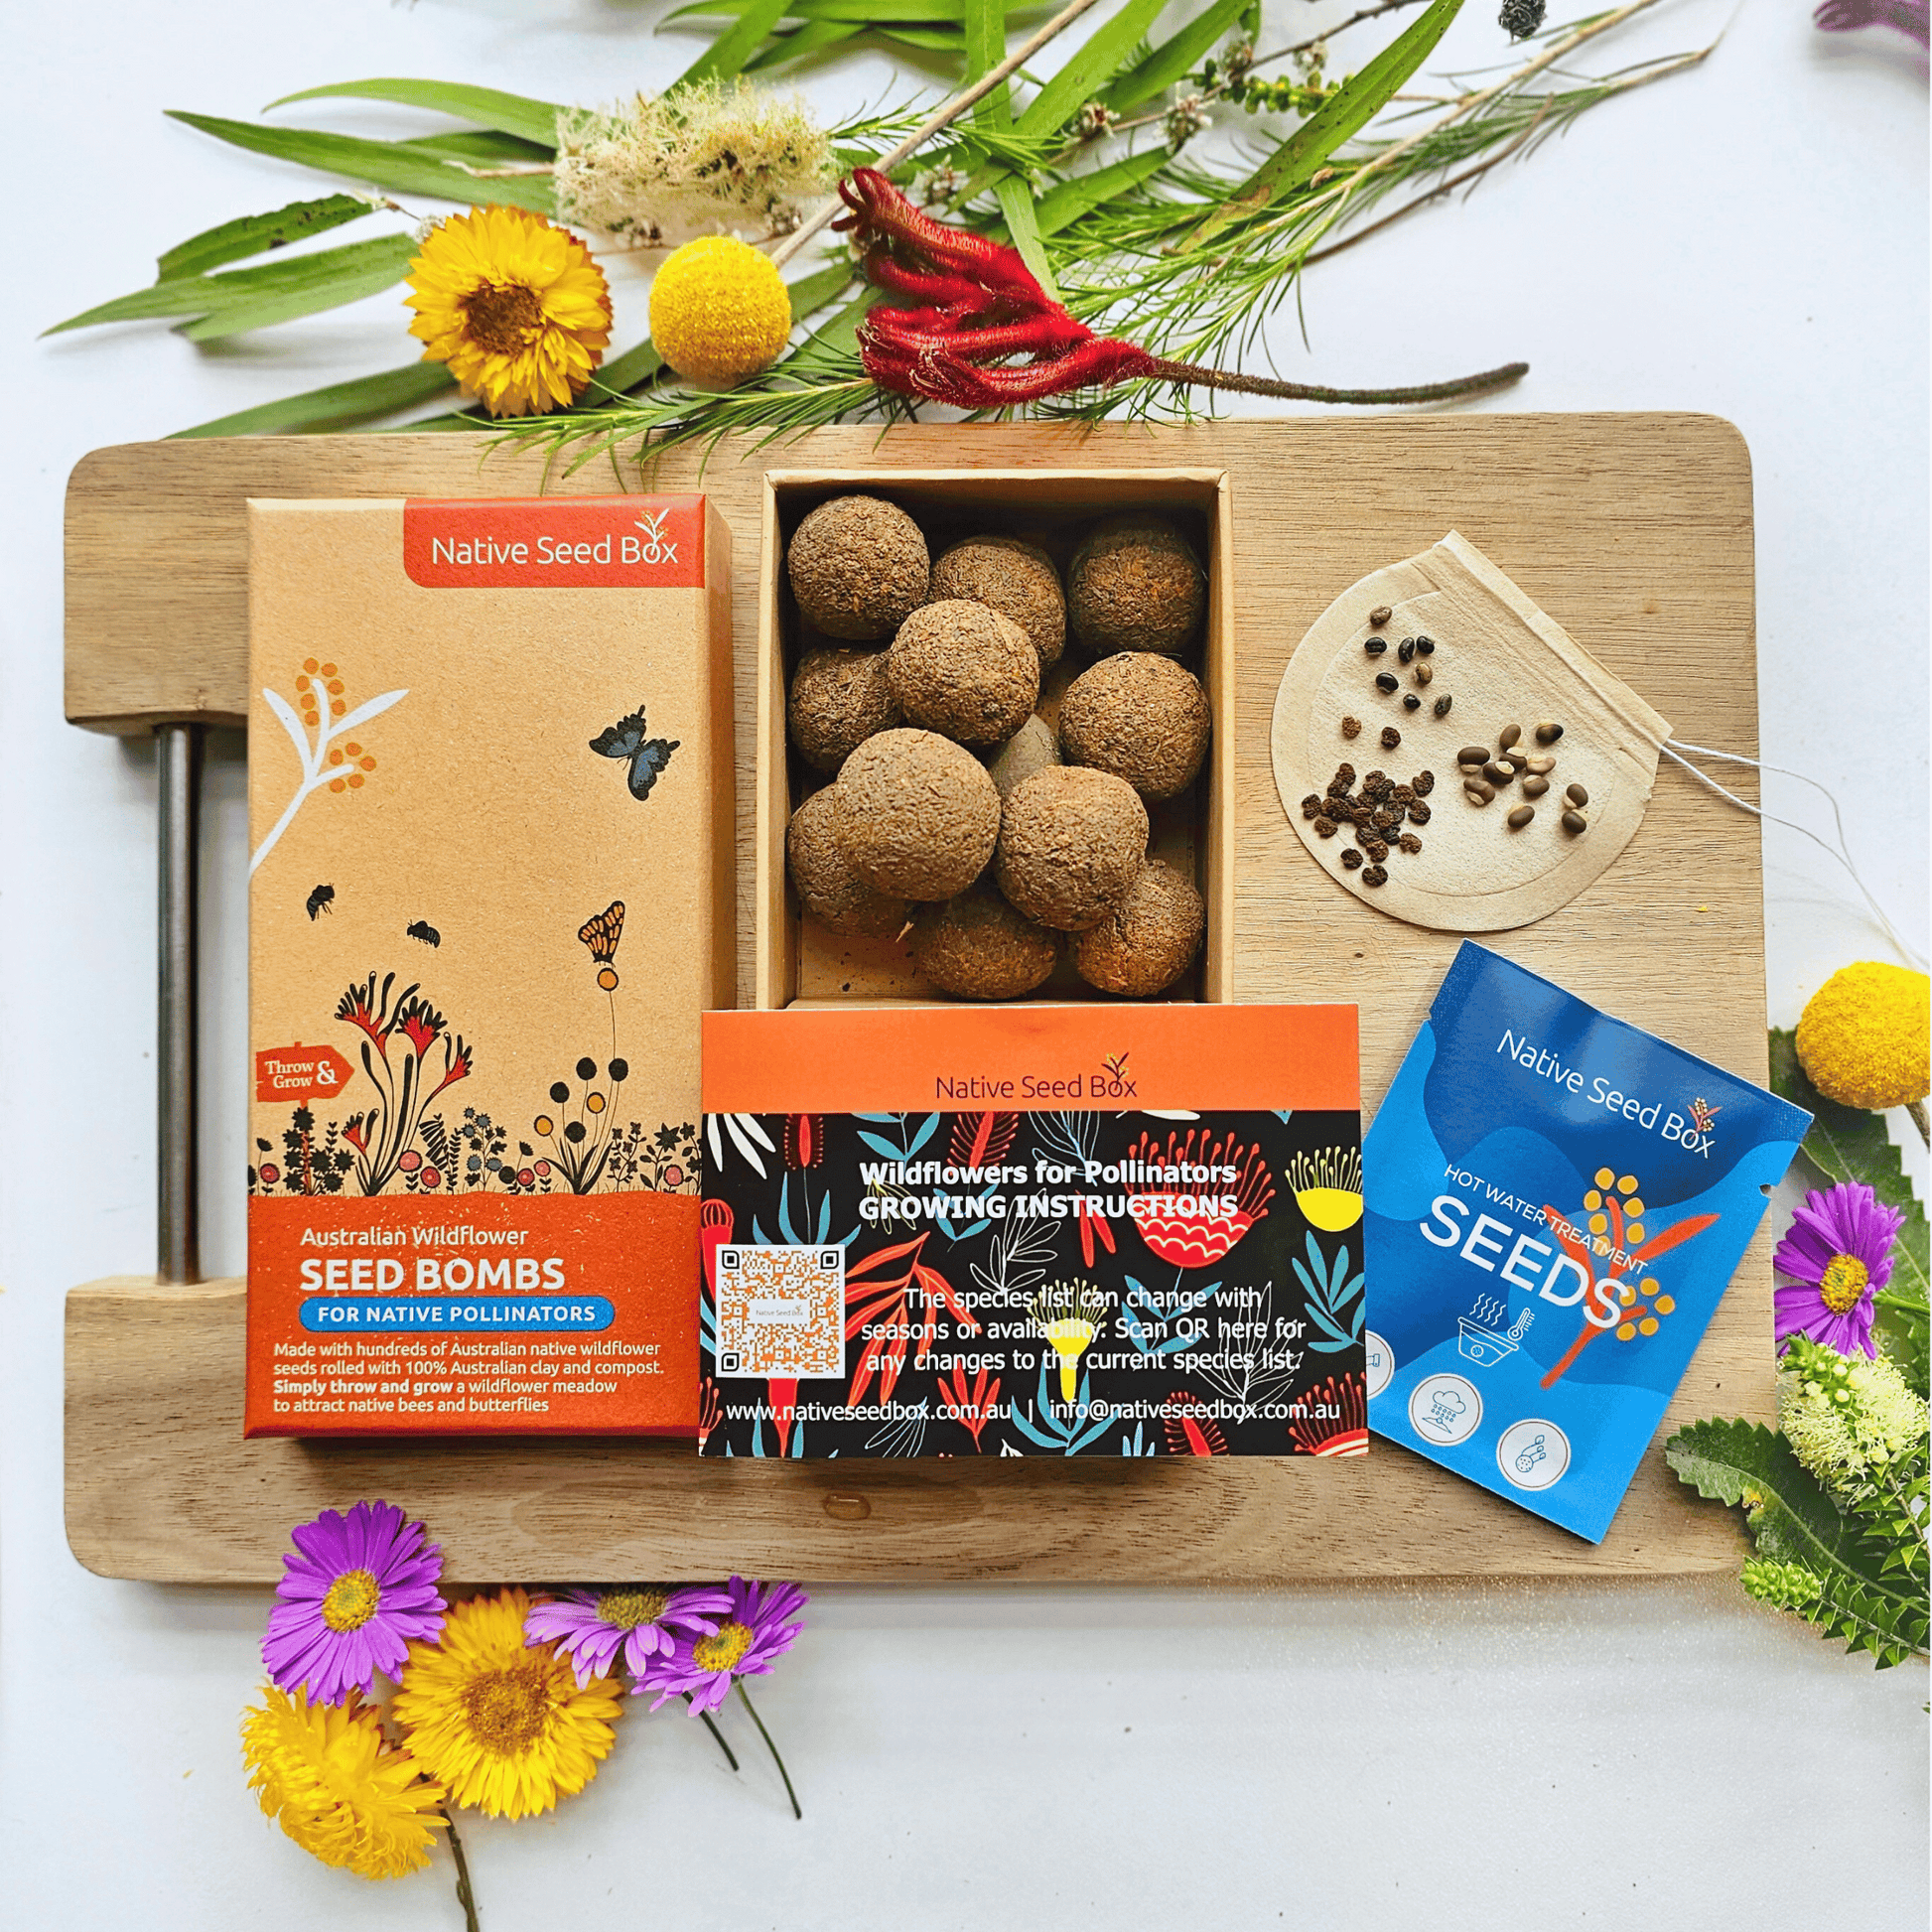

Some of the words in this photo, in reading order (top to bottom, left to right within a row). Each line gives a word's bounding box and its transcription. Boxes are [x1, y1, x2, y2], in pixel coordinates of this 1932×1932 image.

[432, 536, 529, 564] Native
[536, 534, 612, 564] Seed
[621, 536, 678, 564] Box
[264, 1060, 315, 1074] Throw
[317, 1060, 339, 1085] &
[273, 1075, 313, 1088] Grow
[936, 1076, 1014, 1099] Native
[1022, 1074, 1082, 1098] Seed
[1090, 1076, 1138, 1098] Box
[1496, 1029, 1585, 1093] Native
[1587, 1077, 1662, 1130] Seed
[1661, 1112, 1716, 1159] Box
[859, 1162, 1028, 1185] Wildflowers
[1035, 1161, 1076, 1183] for
[1085, 1160, 1237, 1183] Pollinators
[859, 1195, 1007, 1219] GROWING
[1017, 1194, 1238, 1218] INSTRUCTIONS
[1444, 1164, 1484, 1191] HOT
[1485, 1183, 1547, 1226] WATER
[1549, 1215, 1648, 1275] TREATMENT
[301, 1226, 406, 1246] Australian
[413, 1225, 528, 1246] Wildflower
[1420, 1194, 1630, 1328] SEEDS
[300, 1258, 404, 1292] SEED
[417, 1257, 565, 1291] BOMBS
[903, 1288, 945, 1309] The
[953, 1288, 1033, 1313] species
[1041, 1287, 1073, 1309] list
[1080, 1291, 1119, 1308] can
[1126, 1287, 1207, 1312] change
[1215, 1287, 1262, 1308] with
[318, 1306, 359, 1322] FOR
[366, 1306, 443, 1322] NATIVE
[450, 1306, 596, 1321] POLLINATORS
[861, 1323, 950, 1340] seasons
[956, 1322, 981, 1340] or
[987, 1317, 1106, 1344] availability.
[1114, 1317, 1169, 1339] Scan
[1175, 1318, 1210, 1343] QR
[1217, 1317, 1268, 1339] here
[1275, 1317, 1307, 1339] for
[274, 1342, 316, 1357] Made
[319, 1341, 352, 1357] with
[356, 1341, 427, 1357] hundreds
[430, 1341, 448, 1356] of
[450, 1341, 527, 1356] Australian
[530, 1341, 577, 1356] native
[580, 1340, 661, 1356] wildflower
[274, 1360, 318, 1375] seeds
[321, 1360, 364, 1375] rolled
[368, 1360, 401, 1375] with
[405, 1360, 447, 1375] 100%
[450, 1360, 527, 1375] Australian
[530, 1360, 560, 1377] clay
[563, 1360, 591, 1374] and
[595, 1361, 664, 1377] compost.
[866, 1353, 905, 1374] any
[914, 1349, 1005, 1374] changes
[1012, 1351, 1035, 1370] to
[1042, 1348, 1078, 1370] the
[1085, 1349, 1167, 1370] current
[1173, 1348, 1255, 1375] species
[1261, 1348, 1301, 1370] list.
[274, 1379, 328, 1397] Simply
[331, 1379, 378, 1394] throw
[380, 1379, 409, 1394] and
[413, 1381, 454, 1397] grow
[457, 1382, 465, 1394] a
[469, 1378, 551, 1394] wildflower
[553, 1378, 618, 1393] meadow
[274, 1399, 291, 1413] to
[293, 1398, 345, 1413] attract
[348, 1397, 395, 1412] native
[398, 1397, 434, 1412] bees
[437, 1397, 466, 1412] and
[469, 1397, 549, 1412] butterflies
[726, 1399, 1012, 1422] www.nativeseedbox.com.au
[1049, 1398, 1340, 1422] info@nativeseedbox.com.au
